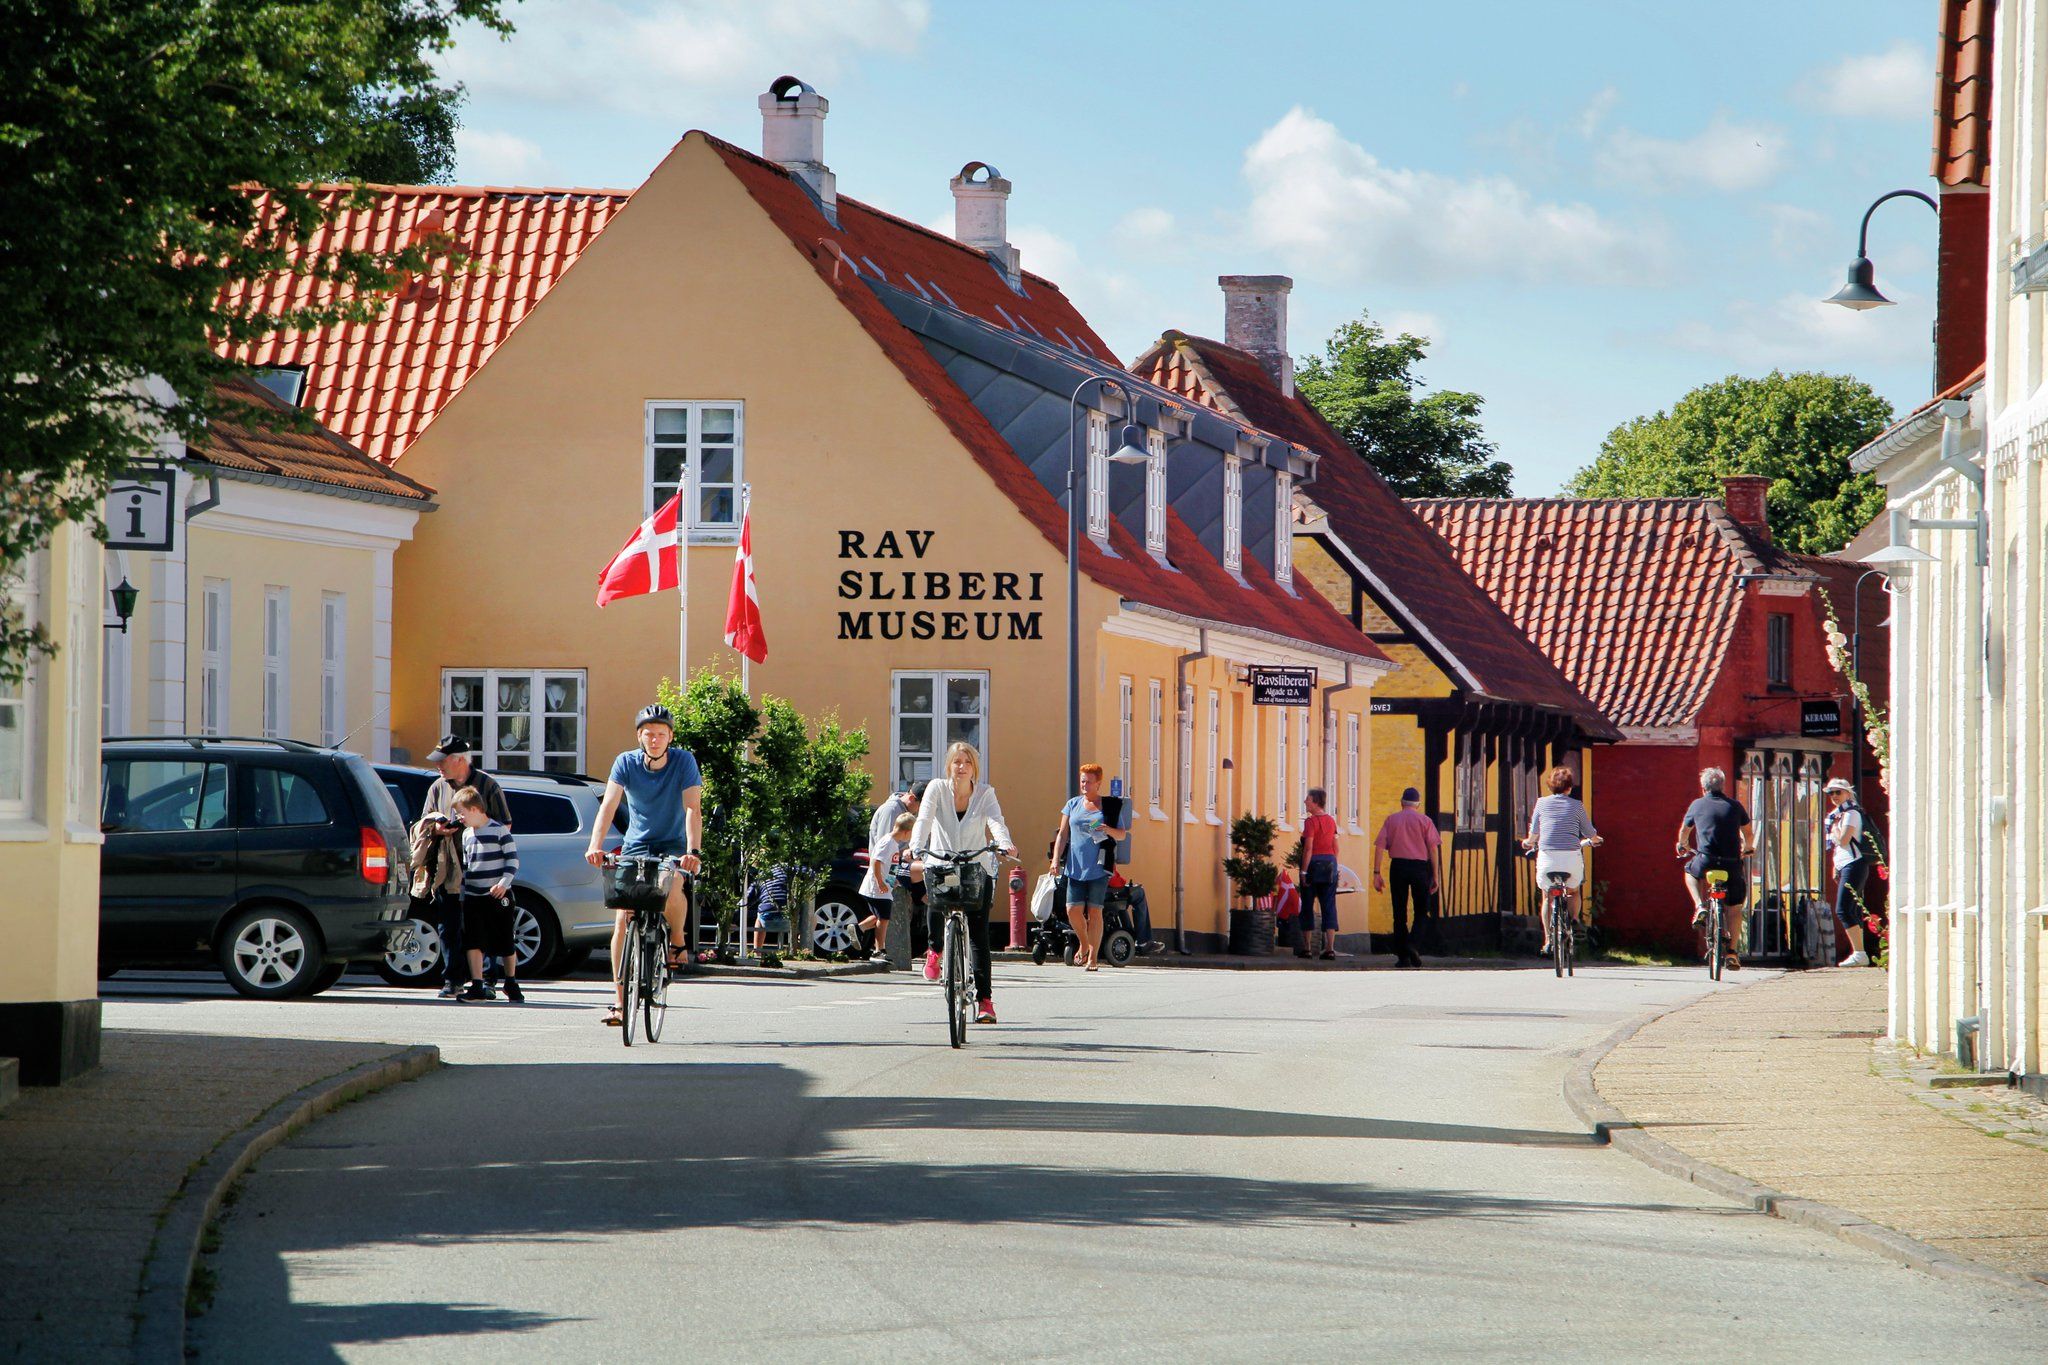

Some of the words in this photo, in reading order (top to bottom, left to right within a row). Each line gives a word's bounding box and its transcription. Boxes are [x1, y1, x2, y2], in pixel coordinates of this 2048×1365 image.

[838, 530, 935, 558] RAV
[838, 570, 1044, 600] SLIBERI
[837, 610, 1043, 640] MUSEUM
[1257, 675, 1308, 686] Ravsliberen
[1265, 688, 1285, 697] Algade
[1805, 713, 1838, 722] KERAMIK
